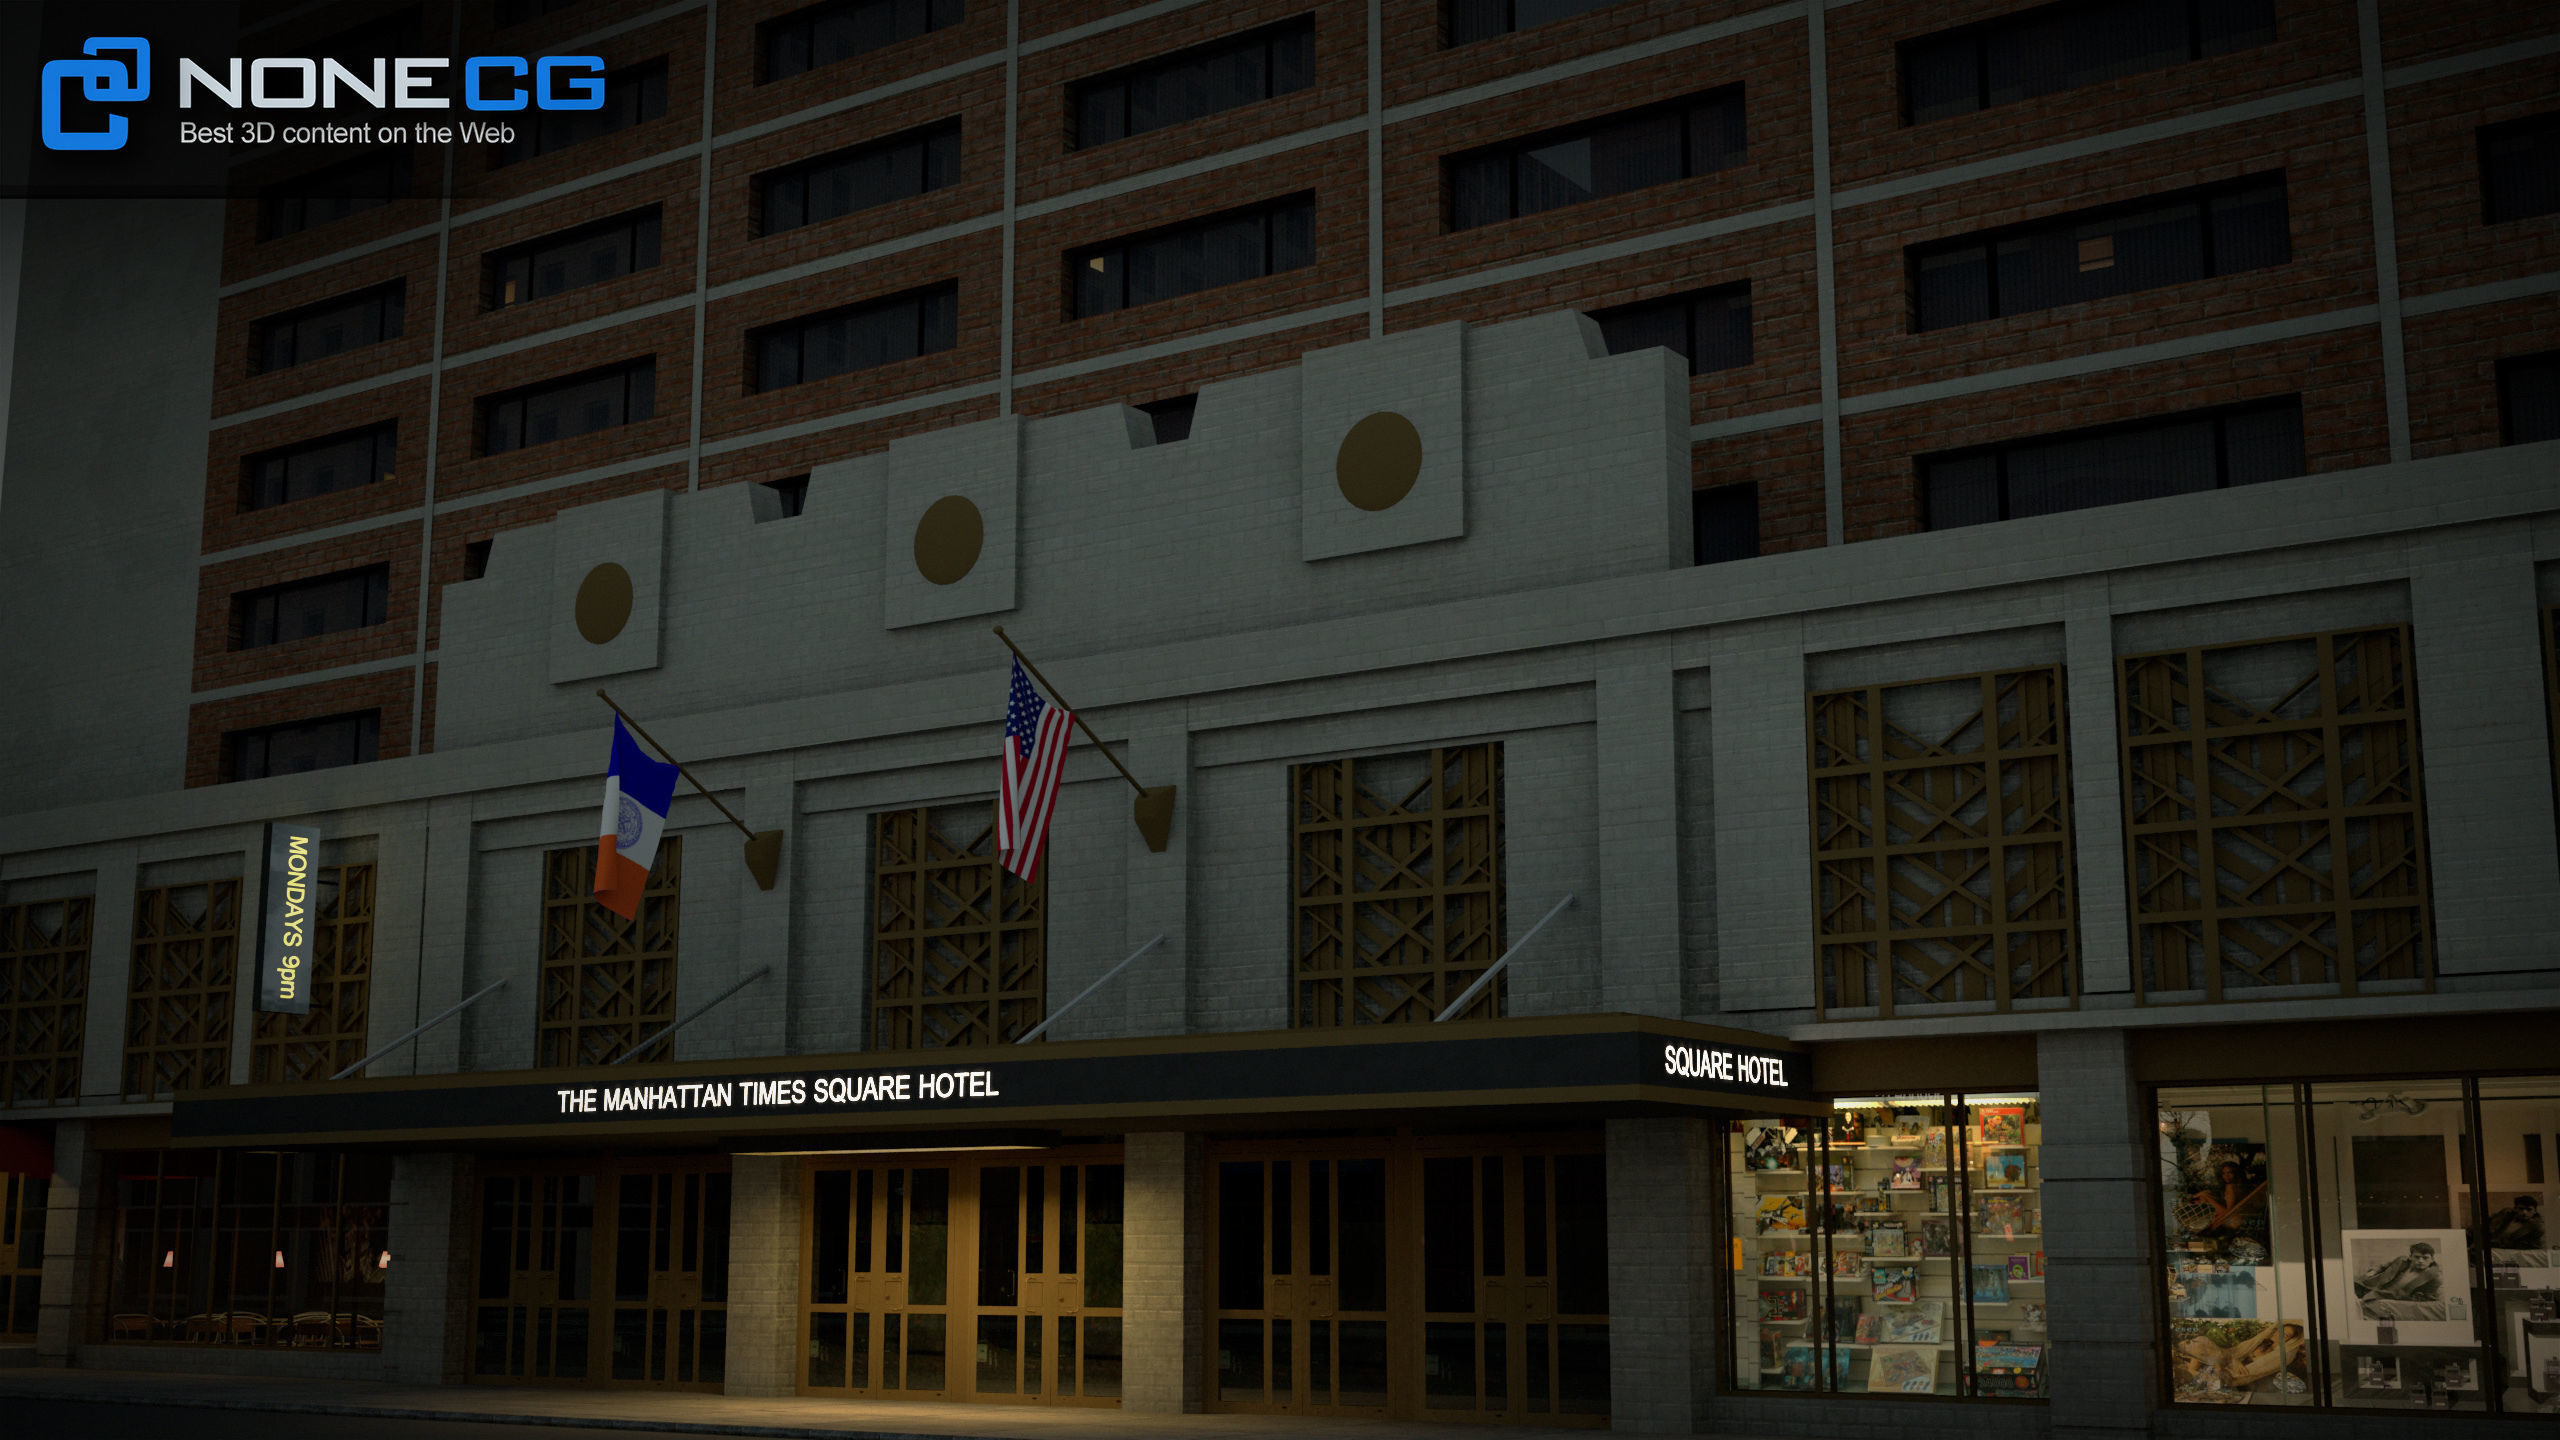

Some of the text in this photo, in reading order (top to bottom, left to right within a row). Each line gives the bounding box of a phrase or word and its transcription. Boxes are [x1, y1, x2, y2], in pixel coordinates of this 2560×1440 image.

[276, 835, 310, 1000] MONDAYS 9pm
[1664, 1044, 1789, 1087] SQUARE HOTEL
[557, 1070, 1000, 1114] THE MANHATTAN TIMES SQUARE HOTEL
